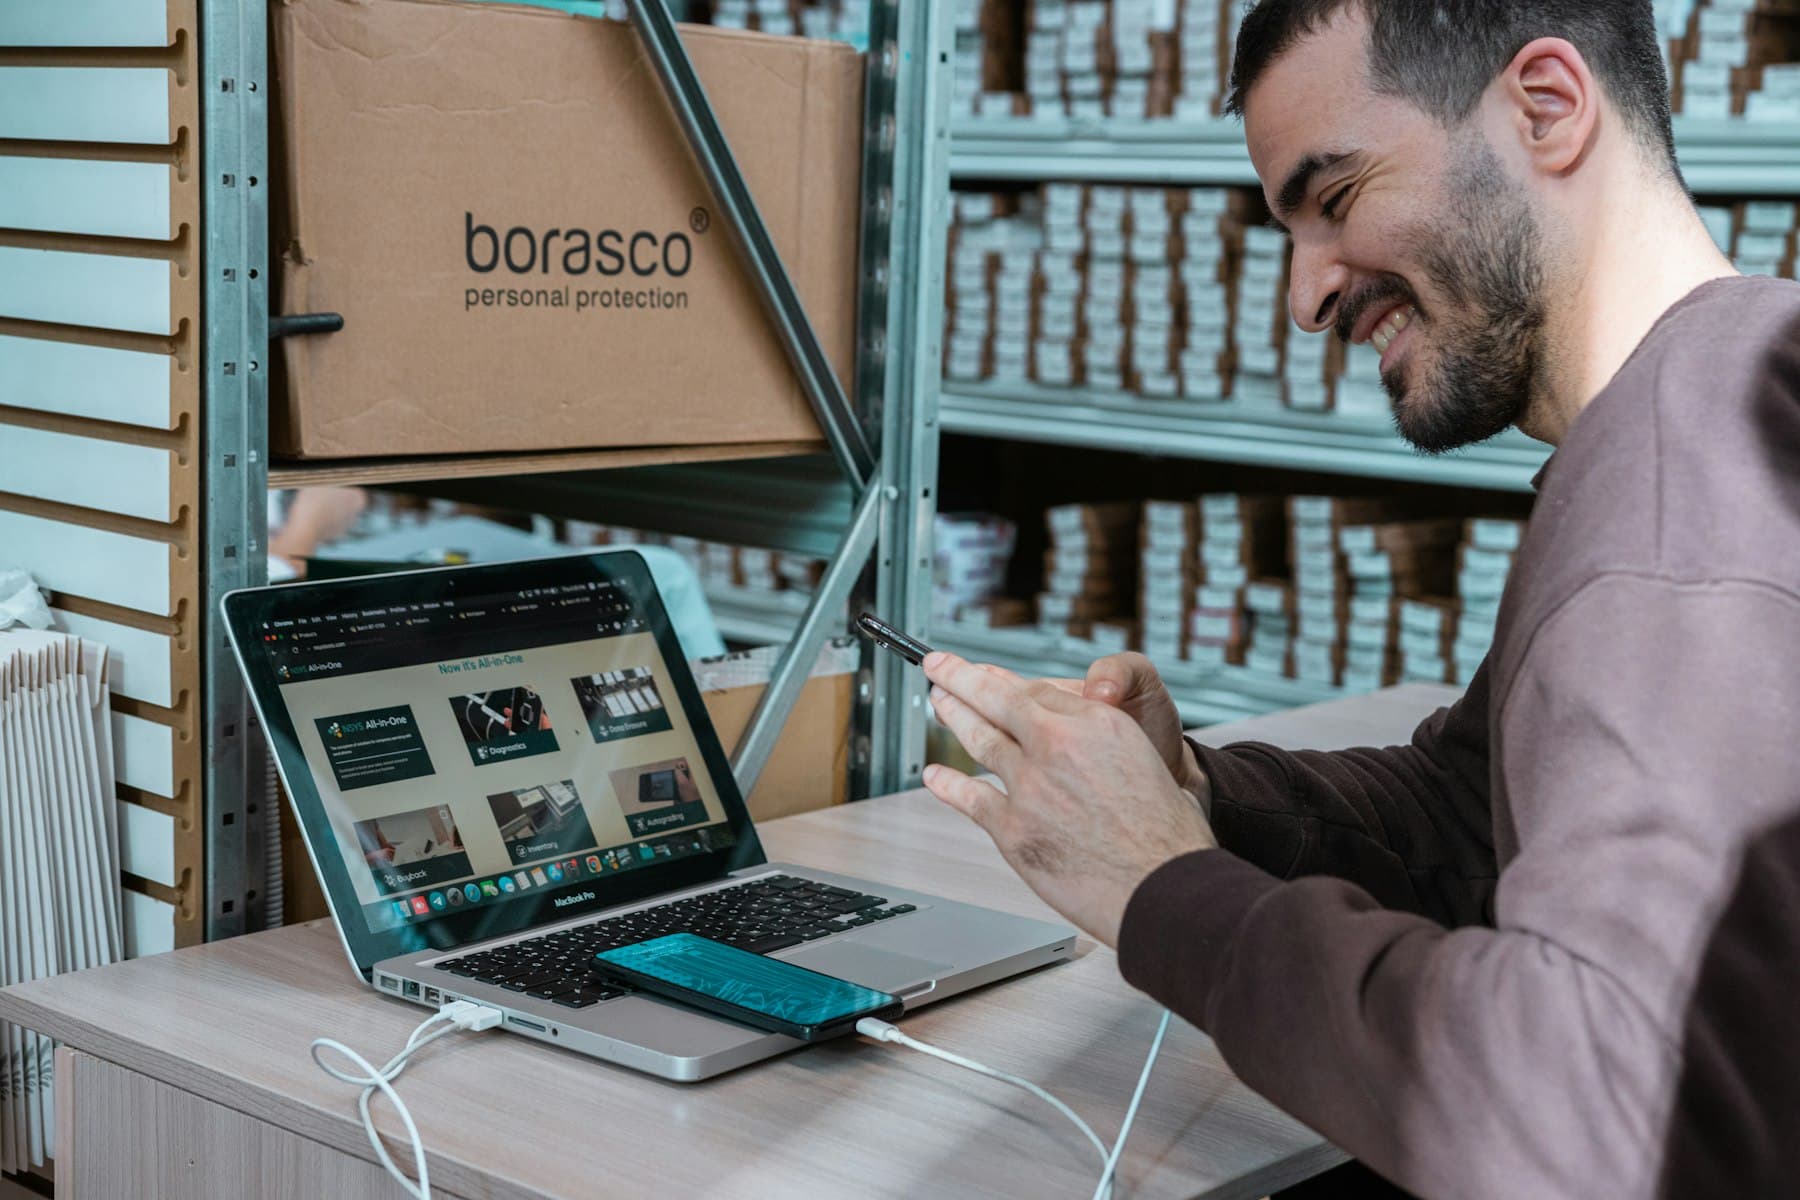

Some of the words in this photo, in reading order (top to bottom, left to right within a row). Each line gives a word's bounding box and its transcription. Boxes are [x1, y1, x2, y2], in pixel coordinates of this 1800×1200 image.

[464, 286, 569, 311] personal
[576, 288, 689, 312] protection
[309, 662, 343, 673] All-in-One
[438, 663, 461, 674] Now
[462, 660, 477, 671] it's
[478, 654, 524, 669] All-in-One
[365, 716, 408, 730] All-in-One
[489, 743, 528, 756] Diagnostics
[527, 841, 559, 854] Inventory
[396, 869, 428, 884] Buyback
[553, 892, 585, 908] MacBook
[582, 890, 596, 901] Pro
